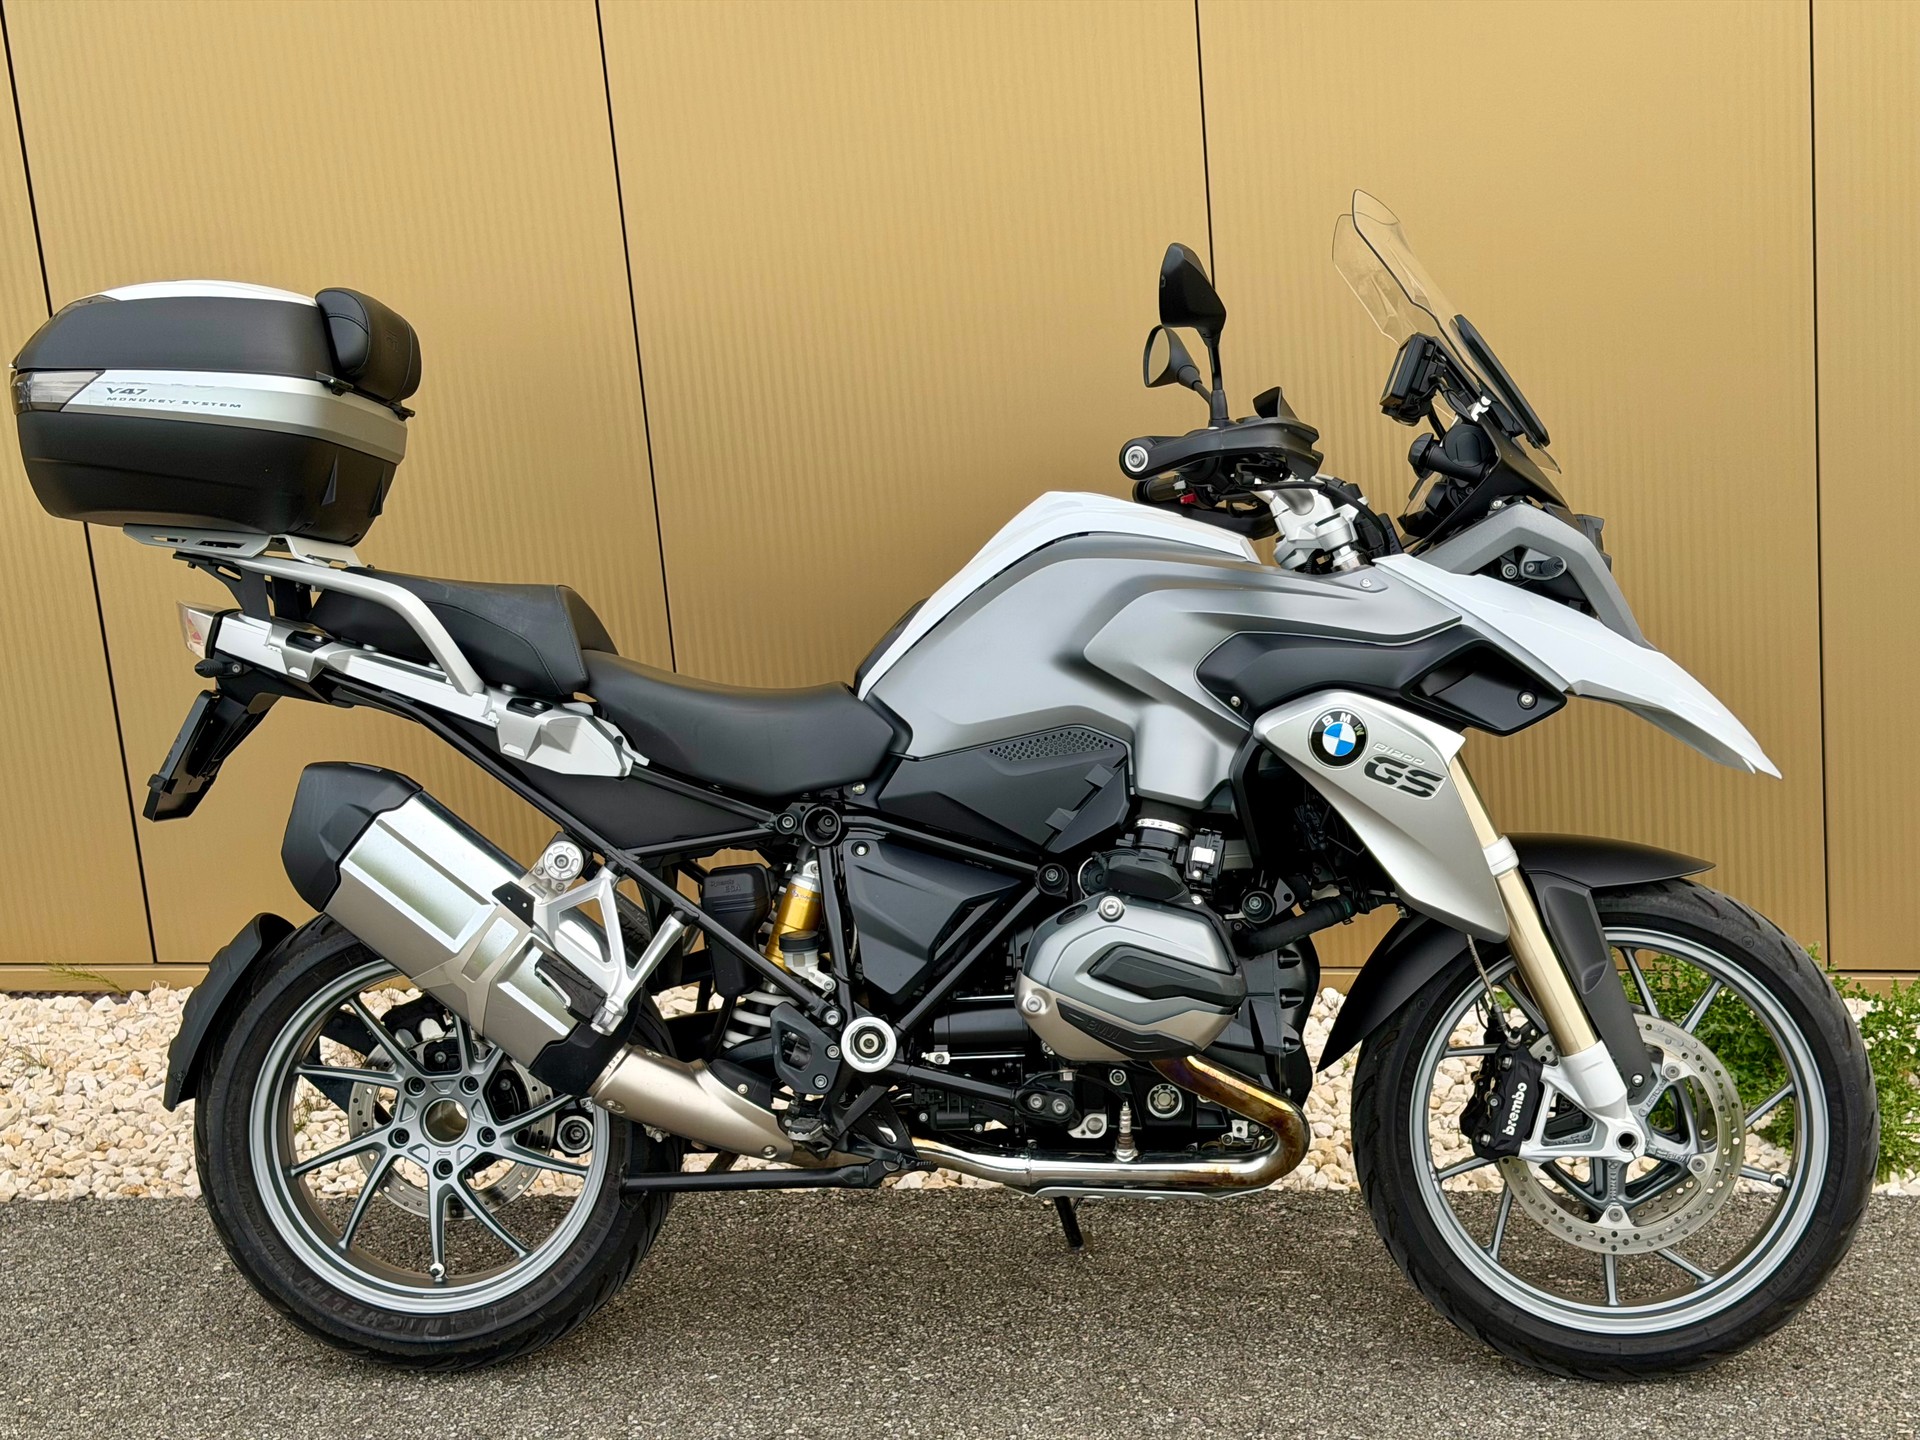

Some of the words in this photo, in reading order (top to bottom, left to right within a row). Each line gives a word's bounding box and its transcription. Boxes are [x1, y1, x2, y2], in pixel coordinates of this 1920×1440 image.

[106, 387, 148, 395] V47
[106, 396, 176, 404] MONOKEY
[182, 400, 242, 408] SYSTEM
[1321, 712, 1365, 736] BMW
[1363, 756, 1444, 799] GS
[1086, 1020, 1121, 1039] BMW
[1502, 1082, 1527, 1136] brembo
